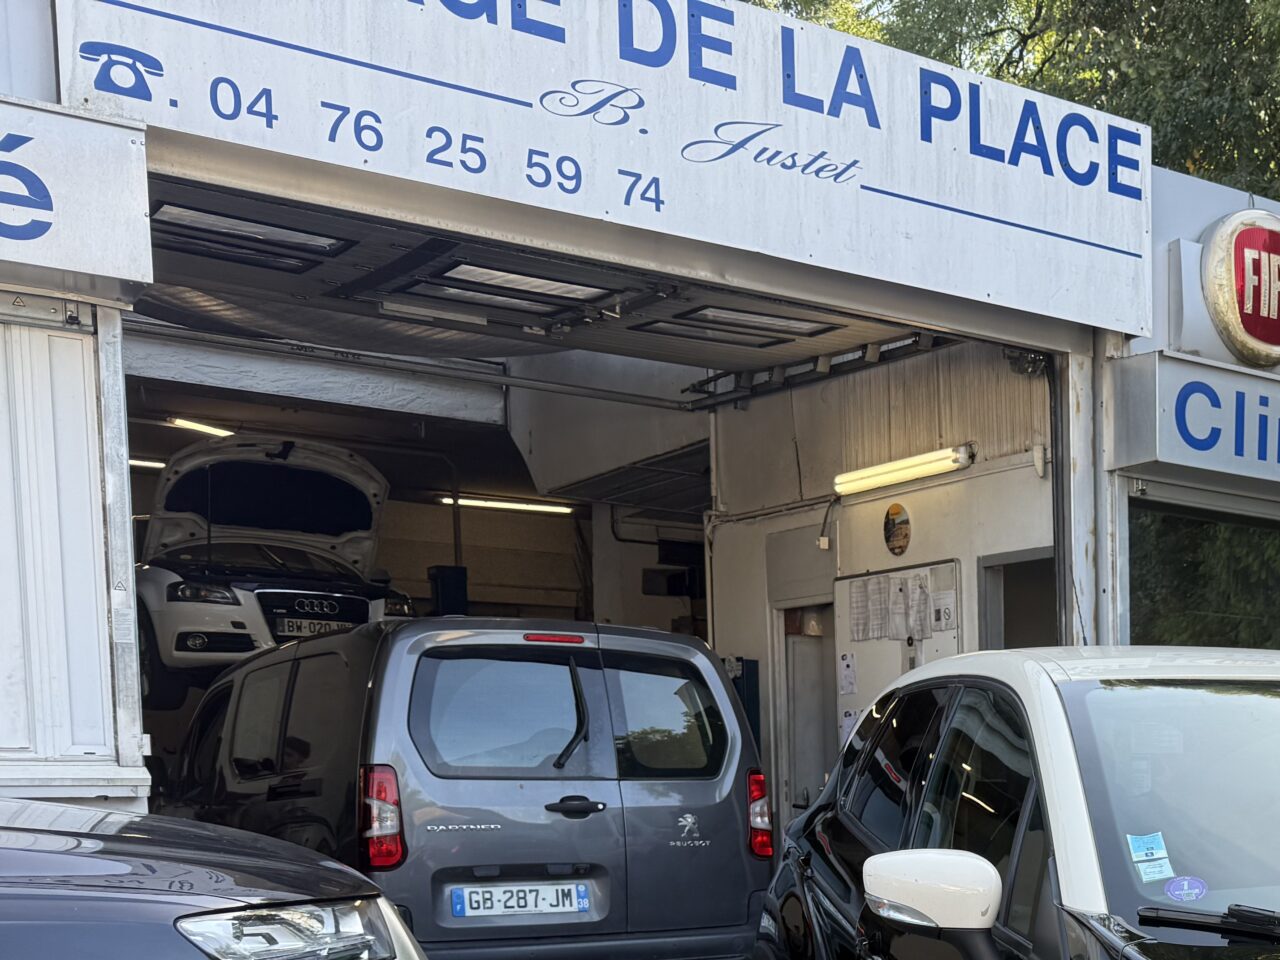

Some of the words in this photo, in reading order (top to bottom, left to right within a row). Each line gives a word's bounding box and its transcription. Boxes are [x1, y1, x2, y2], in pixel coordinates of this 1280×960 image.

[209, 76, 279, 130] 04
[321, 100, 384, 153] 76
[424, 125, 487, 174] 25
[525, 148, 582, 195] 59
[617, 168, 666, 213] 74
[539, 79, 649, 134] B.
[681, 121, 863, 184] Justet
[618, 0, 737, 91] DE
[781, 26, 881, 130] LA
[919, 67, 1142, 201] PLACE
[468, 888, 573, 911] GB-287-JM
[578, 898, 590, 908] 38
